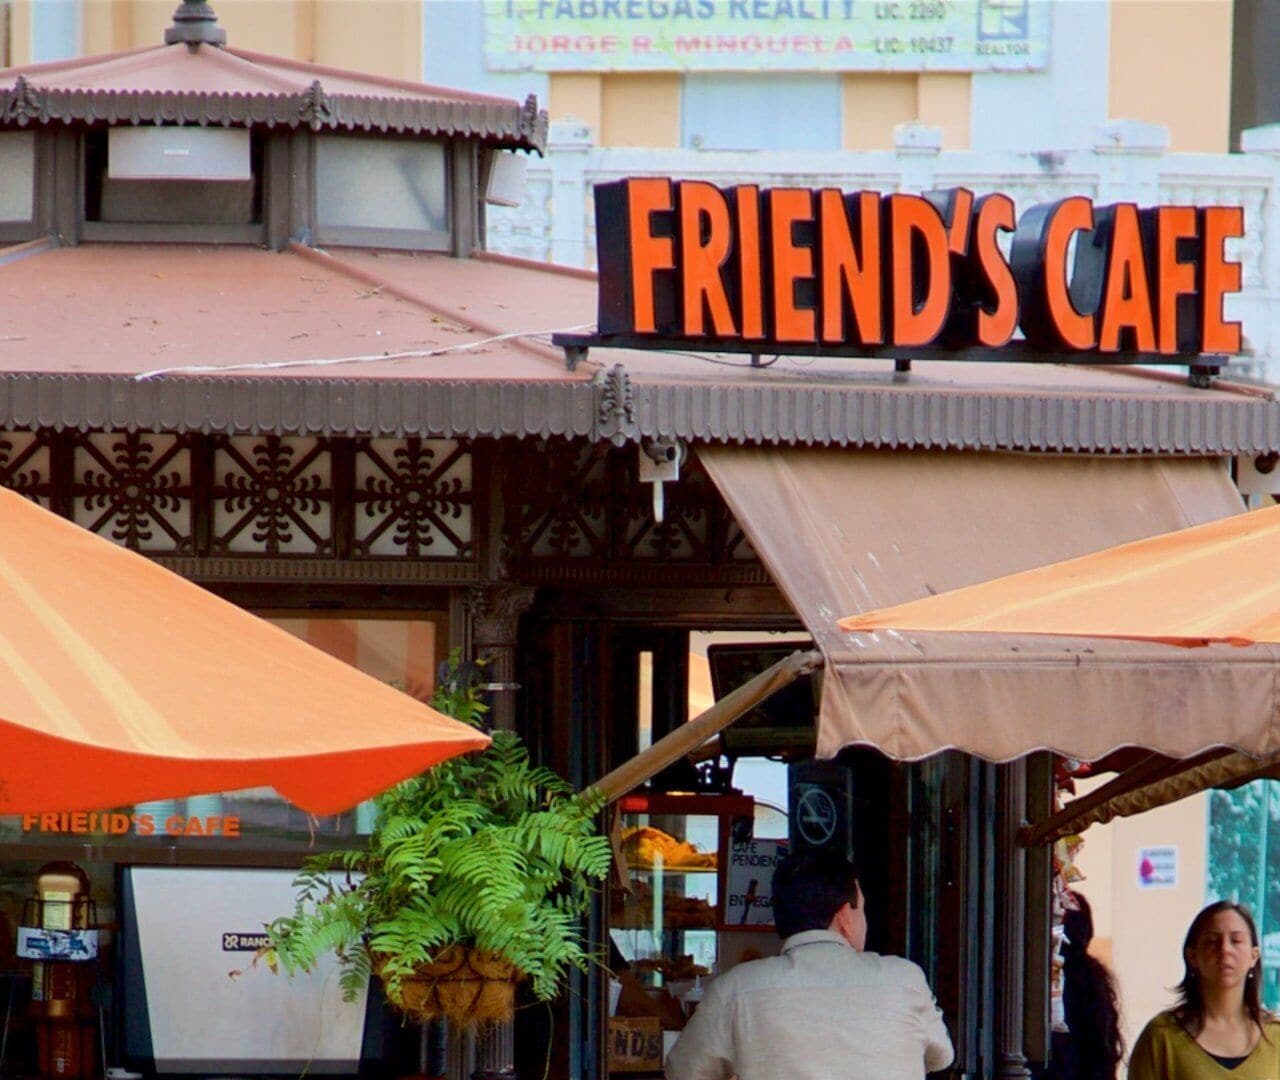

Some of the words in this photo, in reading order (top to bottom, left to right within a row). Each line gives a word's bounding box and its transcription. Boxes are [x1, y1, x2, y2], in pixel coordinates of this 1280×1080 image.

[510, 34, 618, 53] JORGE
[623, 176, 1020, 349] FRIEND'S
[1028, 195, 1245, 356] CAFE
[165, 814, 241, 837] CAFE
